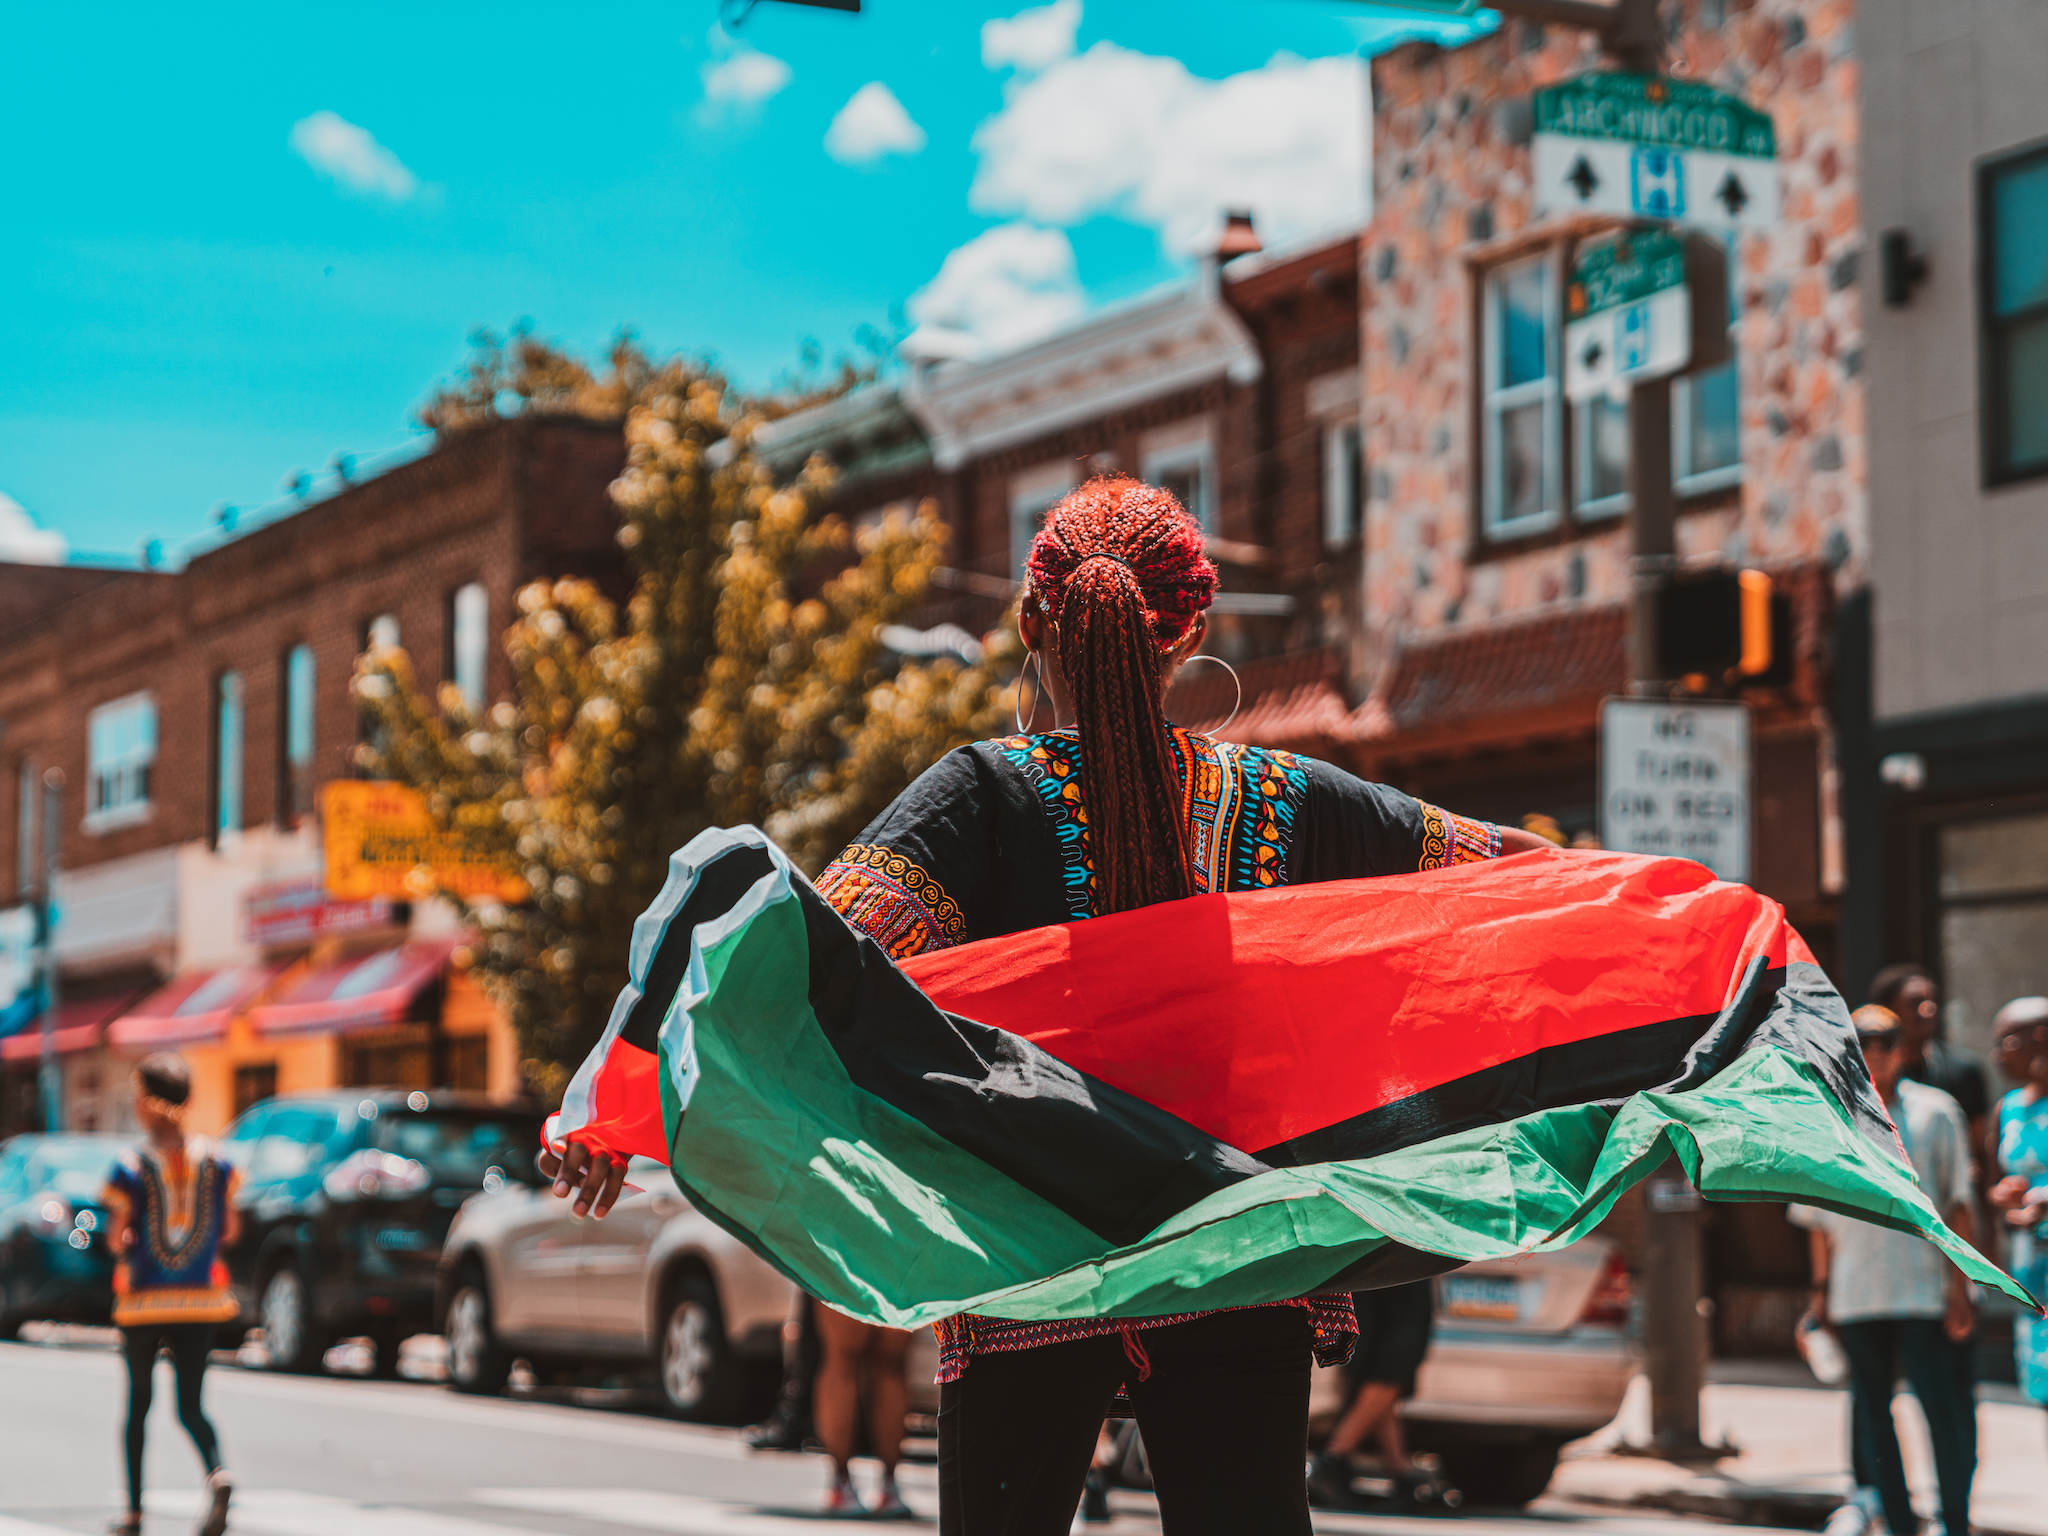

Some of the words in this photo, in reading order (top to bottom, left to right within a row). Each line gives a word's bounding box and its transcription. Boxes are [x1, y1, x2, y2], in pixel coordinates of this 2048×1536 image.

[1655, 711, 1696, 740] NO
[1636, 751, 1720, 783] TURN
[1609, 790, 1657, 822] ON
[1676, 792, 1737, 824] RED
